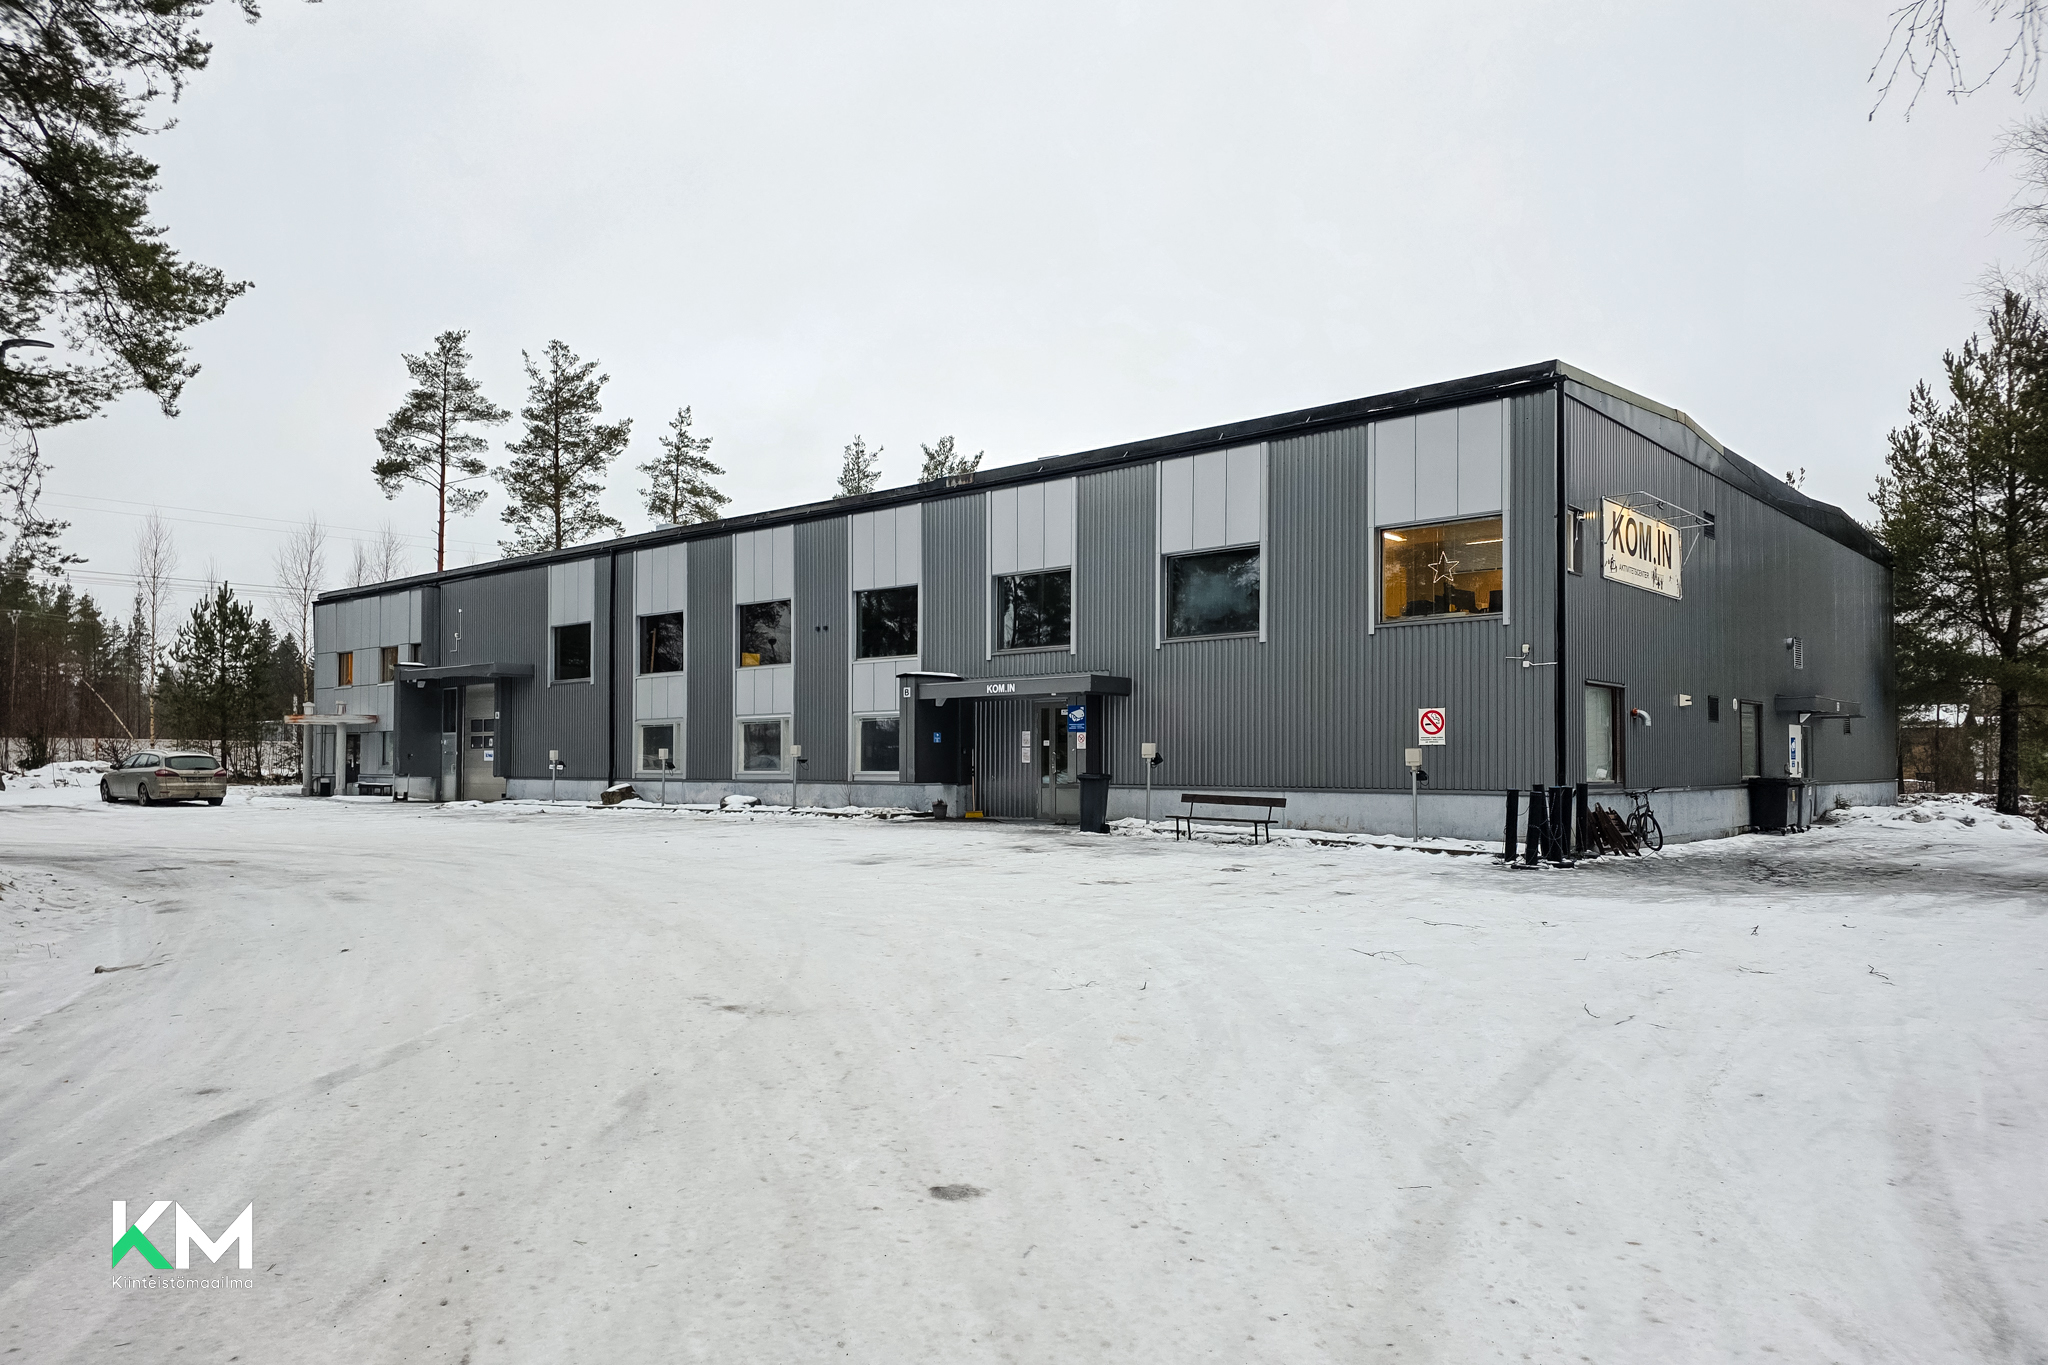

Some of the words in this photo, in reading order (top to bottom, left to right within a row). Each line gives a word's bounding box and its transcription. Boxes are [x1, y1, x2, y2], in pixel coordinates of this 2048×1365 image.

[1612, 511, 1672, 569] KOM.IN
[904, 688, 910, 697] B
[986, 683, 1016, 694] KOM.IN
